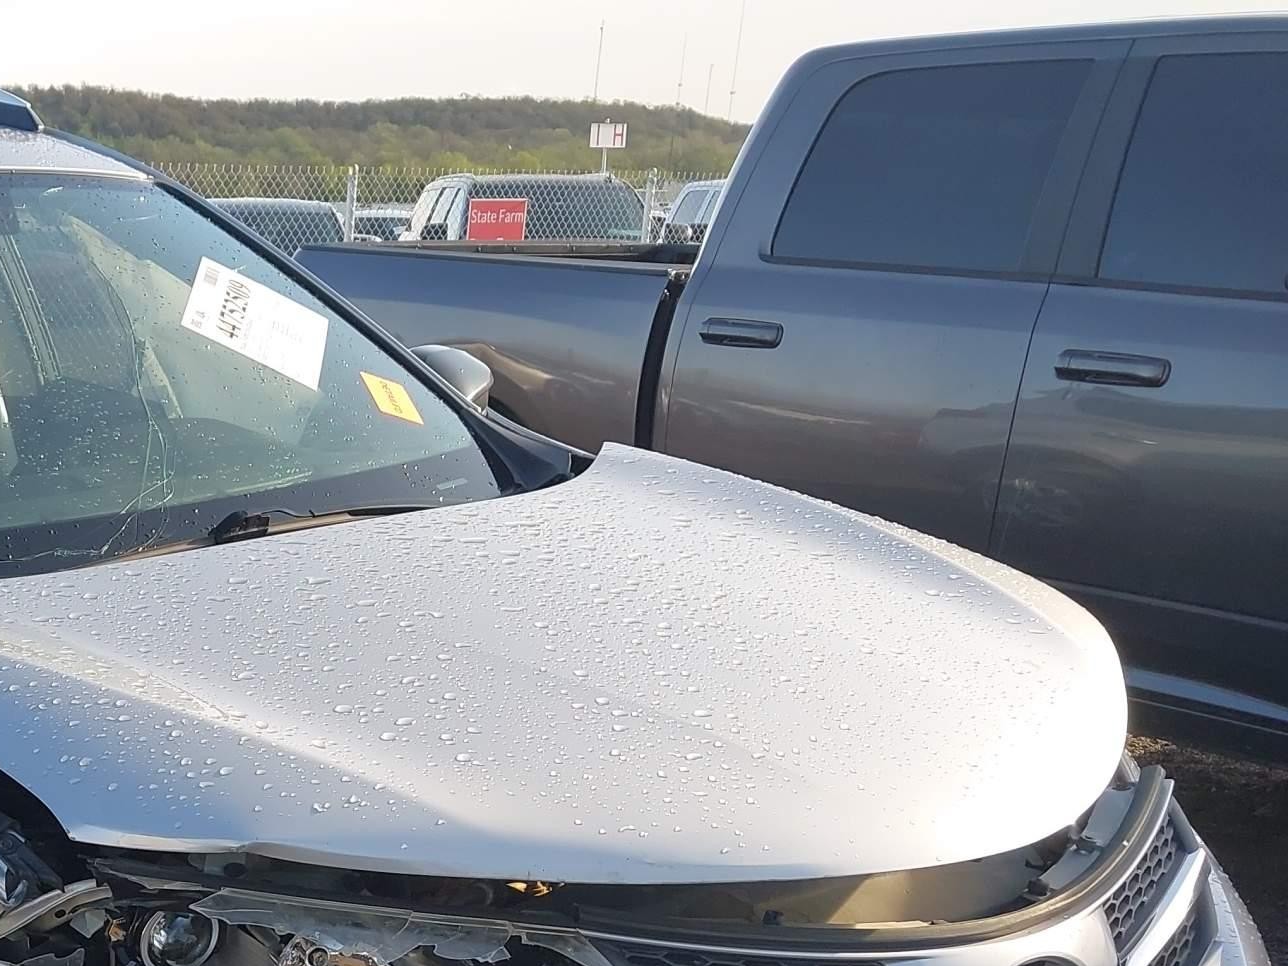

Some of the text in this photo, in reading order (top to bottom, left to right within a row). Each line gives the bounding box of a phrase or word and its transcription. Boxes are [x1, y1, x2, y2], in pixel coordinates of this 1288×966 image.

[613, 123, 625, 147] H
[470, 208, 524, 224] State Farm
[215, 278, 252, 340] 44752509
